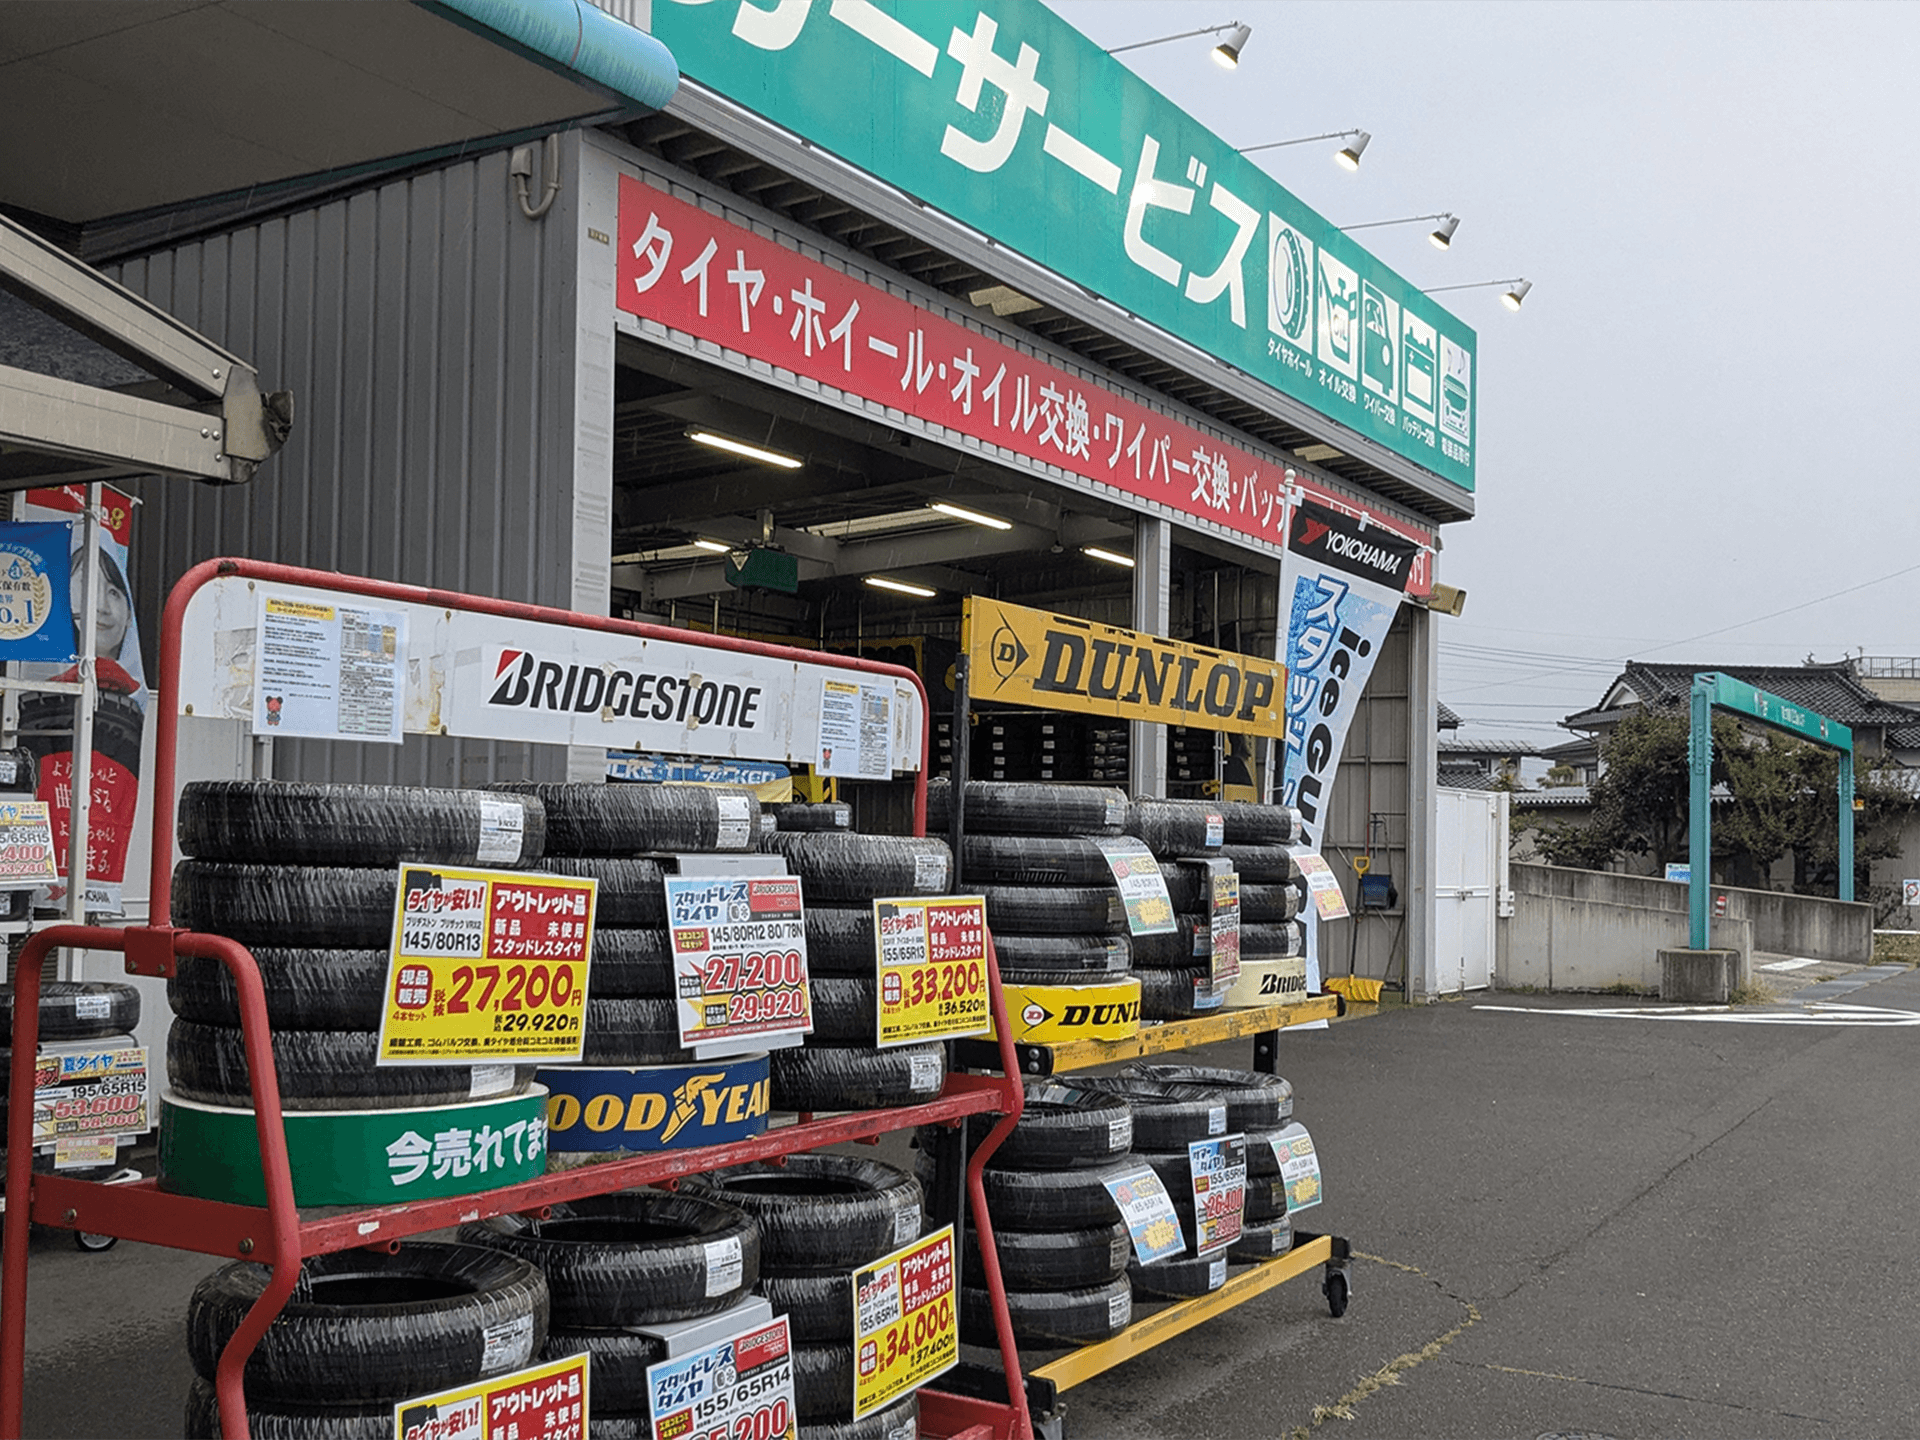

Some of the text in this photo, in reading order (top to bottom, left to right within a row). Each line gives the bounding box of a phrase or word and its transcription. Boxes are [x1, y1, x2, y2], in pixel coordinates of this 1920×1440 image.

[1267, 337, 1313, 378] タイヤホイール
[1318, 367, 1357, 404] オイル交換
[1325, 529, 1402, 575] YOKOHAMA
[489, 649, 762, 729] BRIDGESTONE
[1032, 629, 1275, 722] DUNLOP
[496, 890, 585, 916] アウトレット品
[674, 884, 747, 906] スタッドレス
[676, 905, 719, 921] タイヤ
[929, 909, 981, 927] アウトレット品
[404, 931, 481, 951] 145/80R13
[493, 938, 582, 957] スタッドレスタイヤ
[711, 926, 765, 942] 145/80R12
[932, 945, 981, 959] スタッドレスタイヤ
[705, 956, 800, 992] 27,200
[731, 989, 804, 1022] 29,920
[63, 1055, 113, 1072] 夏タイヤ
[72, 1082, 146, 1098] 195/65R15
[902, 1240, 950, 1279] アウトレット品
[656, 1345, 734, 1395] スタッドレス
[492, 1374, 580, 1420] アウトレット品
[658, 1379, 704, 1409] タイヤ
[695, 1366, 791, 1419] 155/65R14
